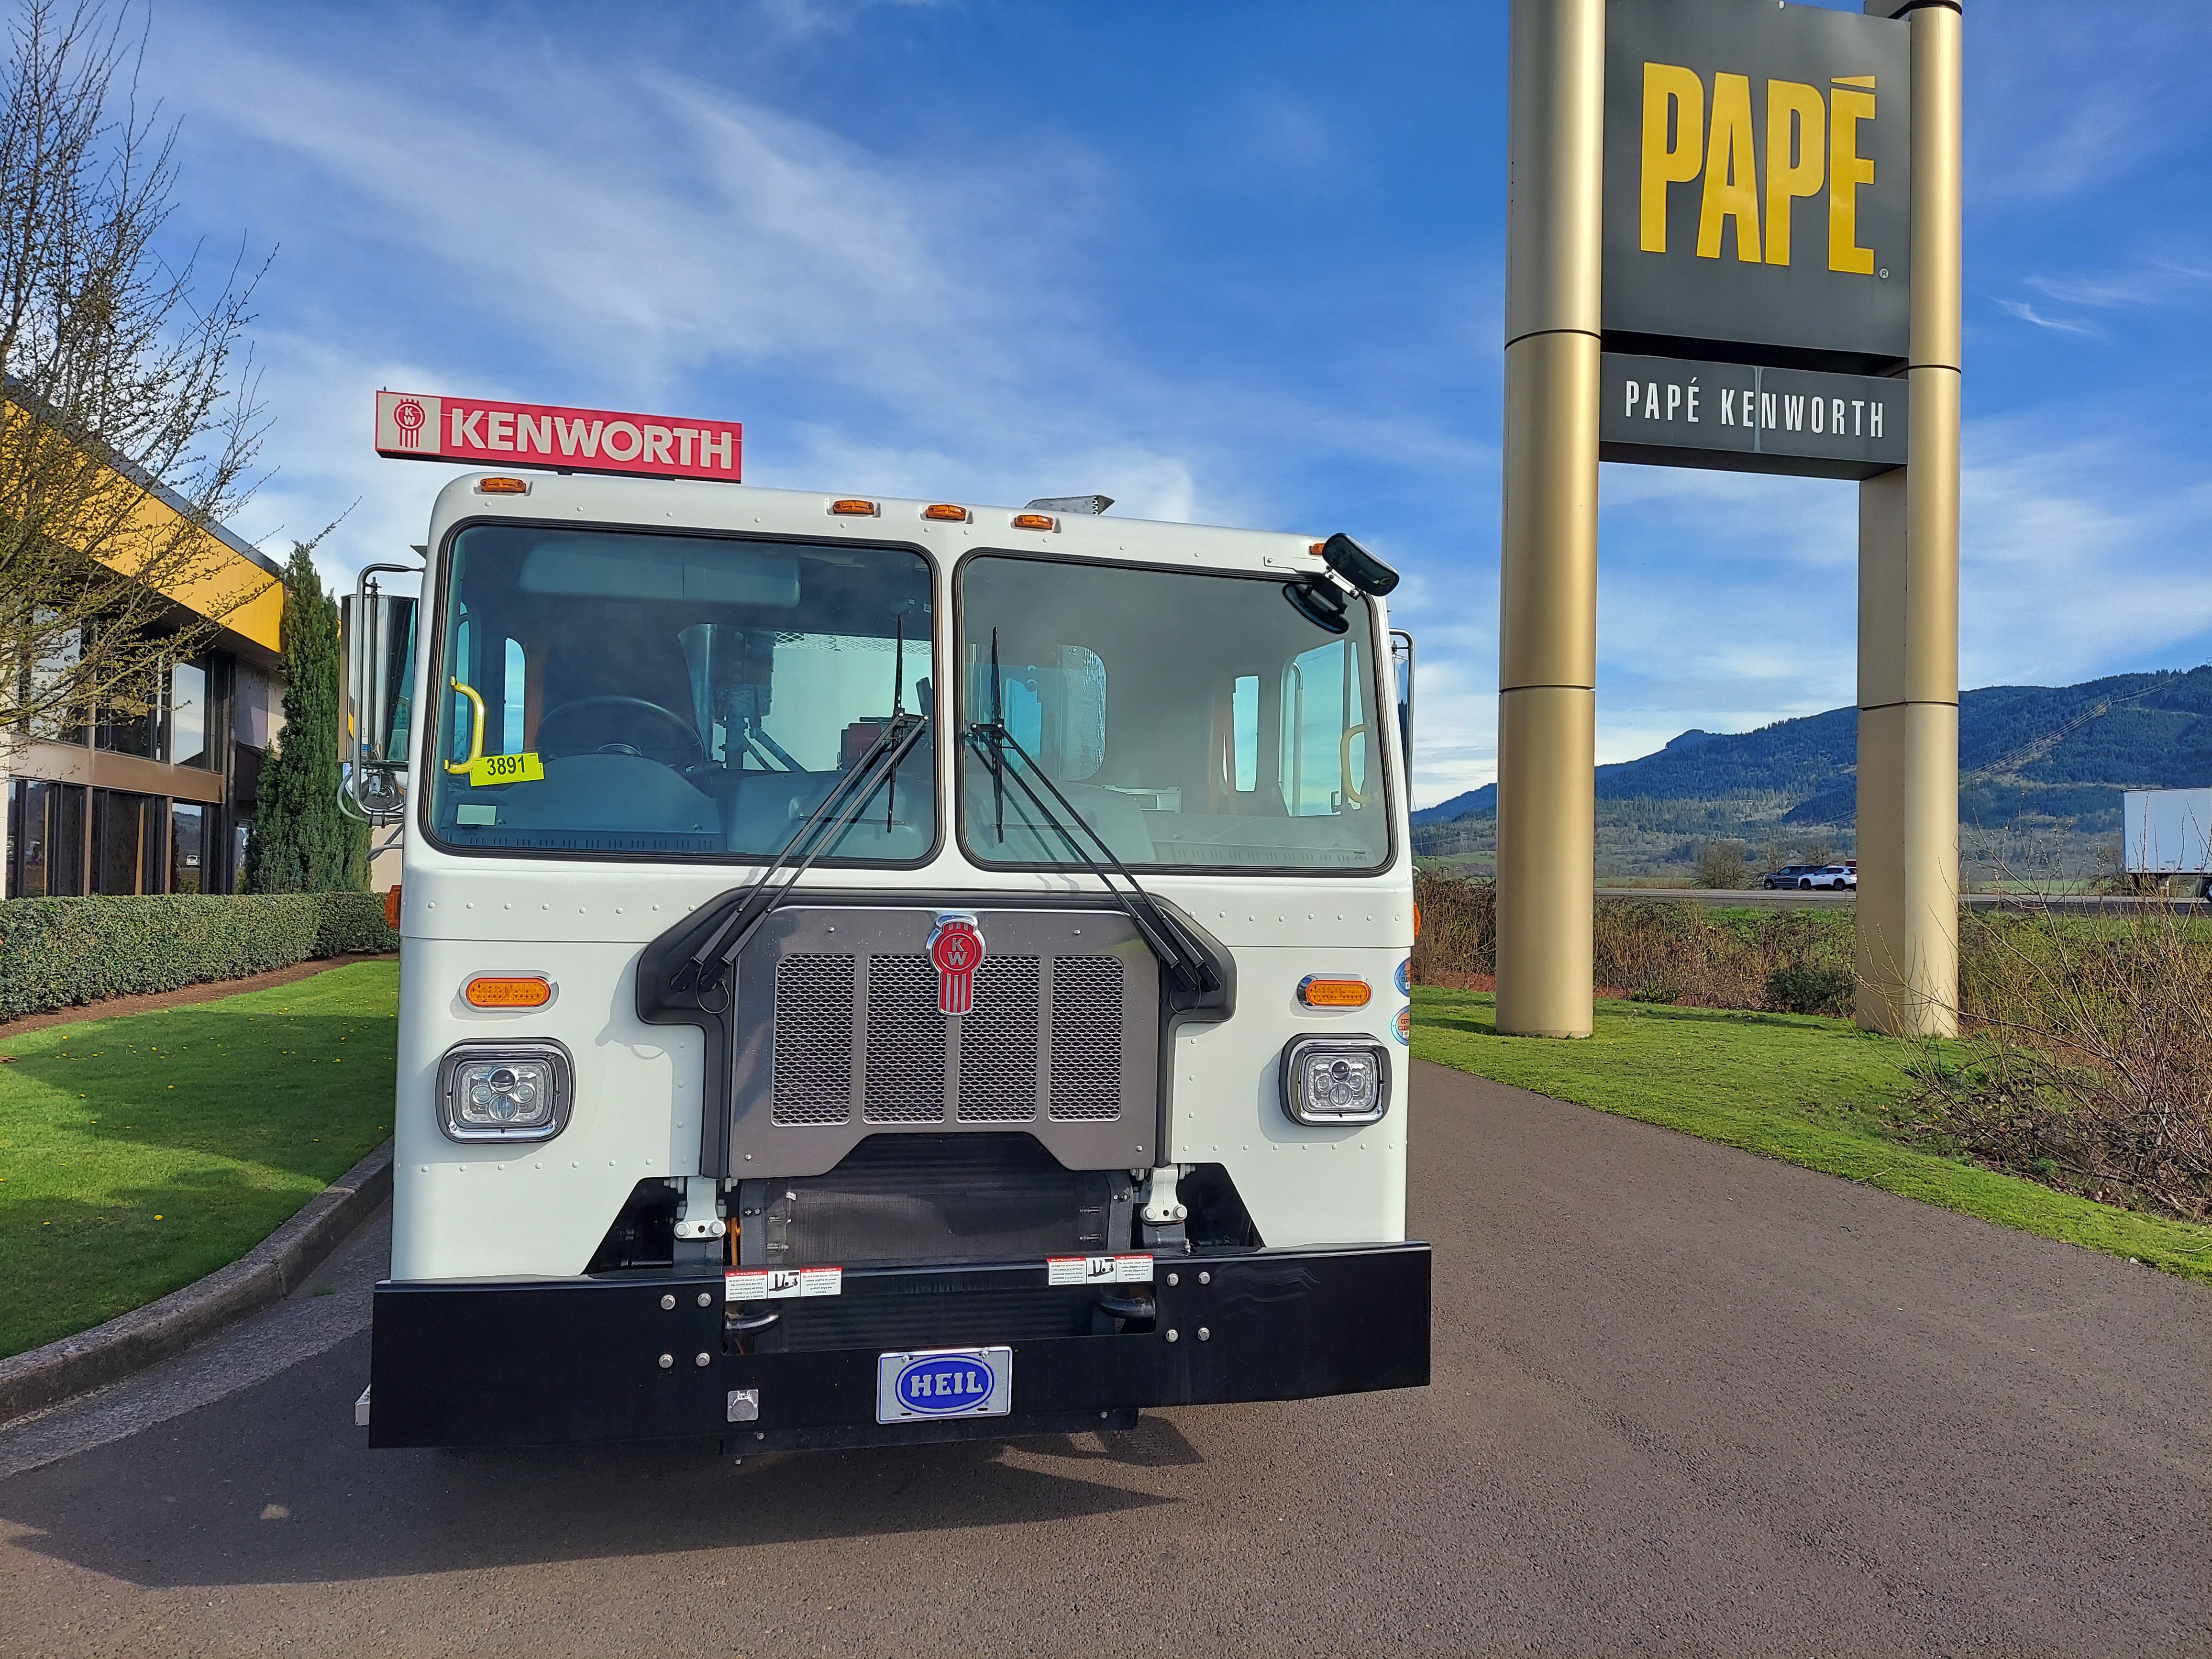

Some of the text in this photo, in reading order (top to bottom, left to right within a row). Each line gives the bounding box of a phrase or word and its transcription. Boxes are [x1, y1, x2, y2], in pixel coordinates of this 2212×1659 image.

[1640, 61, 1876, 275] PAPÉ
[1626, 376, 1883, 438] PAPÉ KENWORTH
[451, 408, 732, 470] KENWORTH
[487, 755, 525, 776] 3891
[910, 1371, 984, 1397] HEIL
